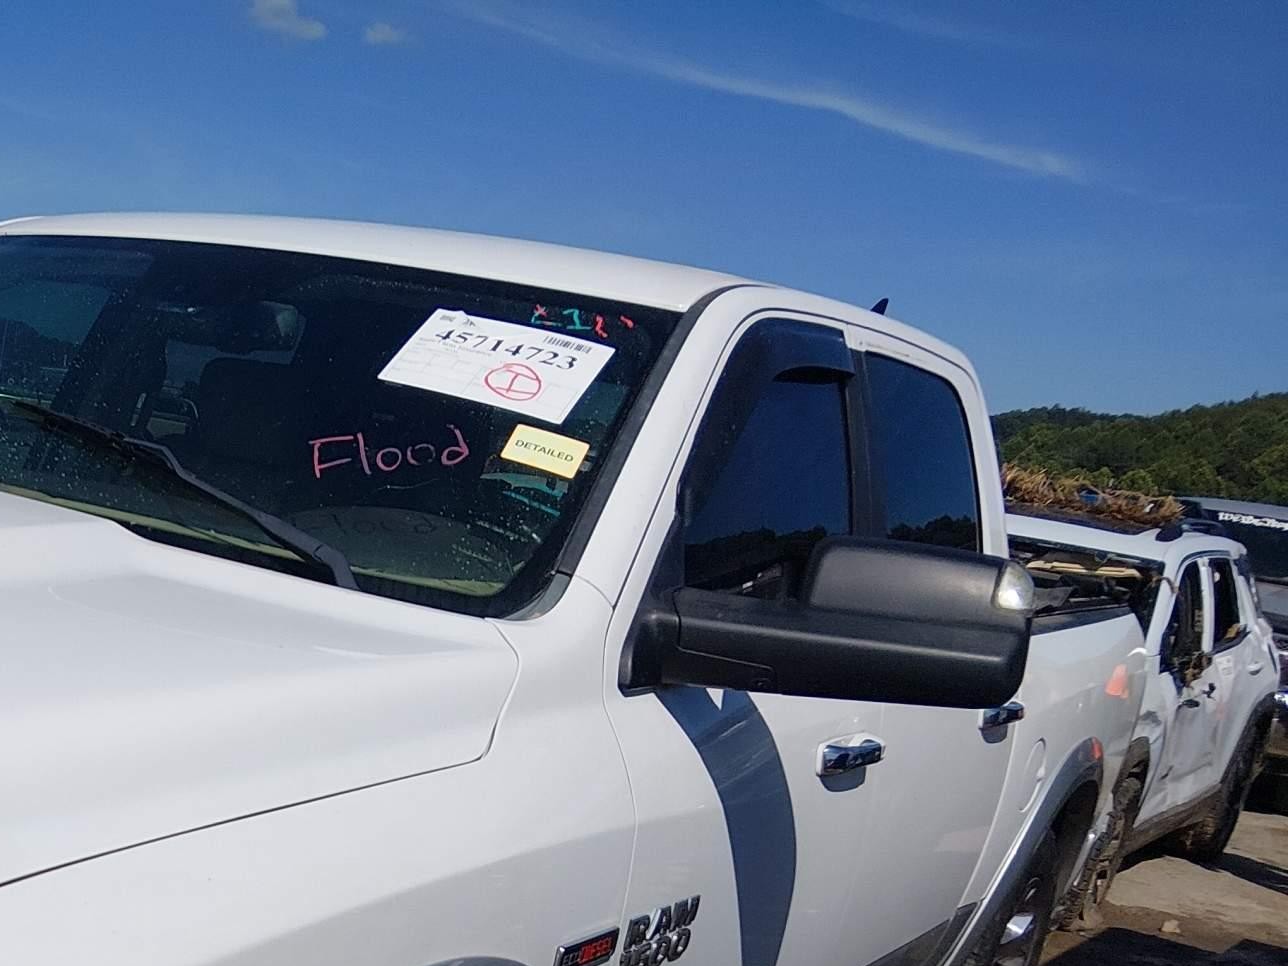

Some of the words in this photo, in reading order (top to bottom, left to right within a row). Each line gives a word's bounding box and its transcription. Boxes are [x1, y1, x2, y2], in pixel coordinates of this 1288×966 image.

[435, 329, 578, 371] 45714723
[309, 424, 470, 479] Flood
[514, 438, 574, 463] DETAILED
[623, 895, 701, 953] RAM
